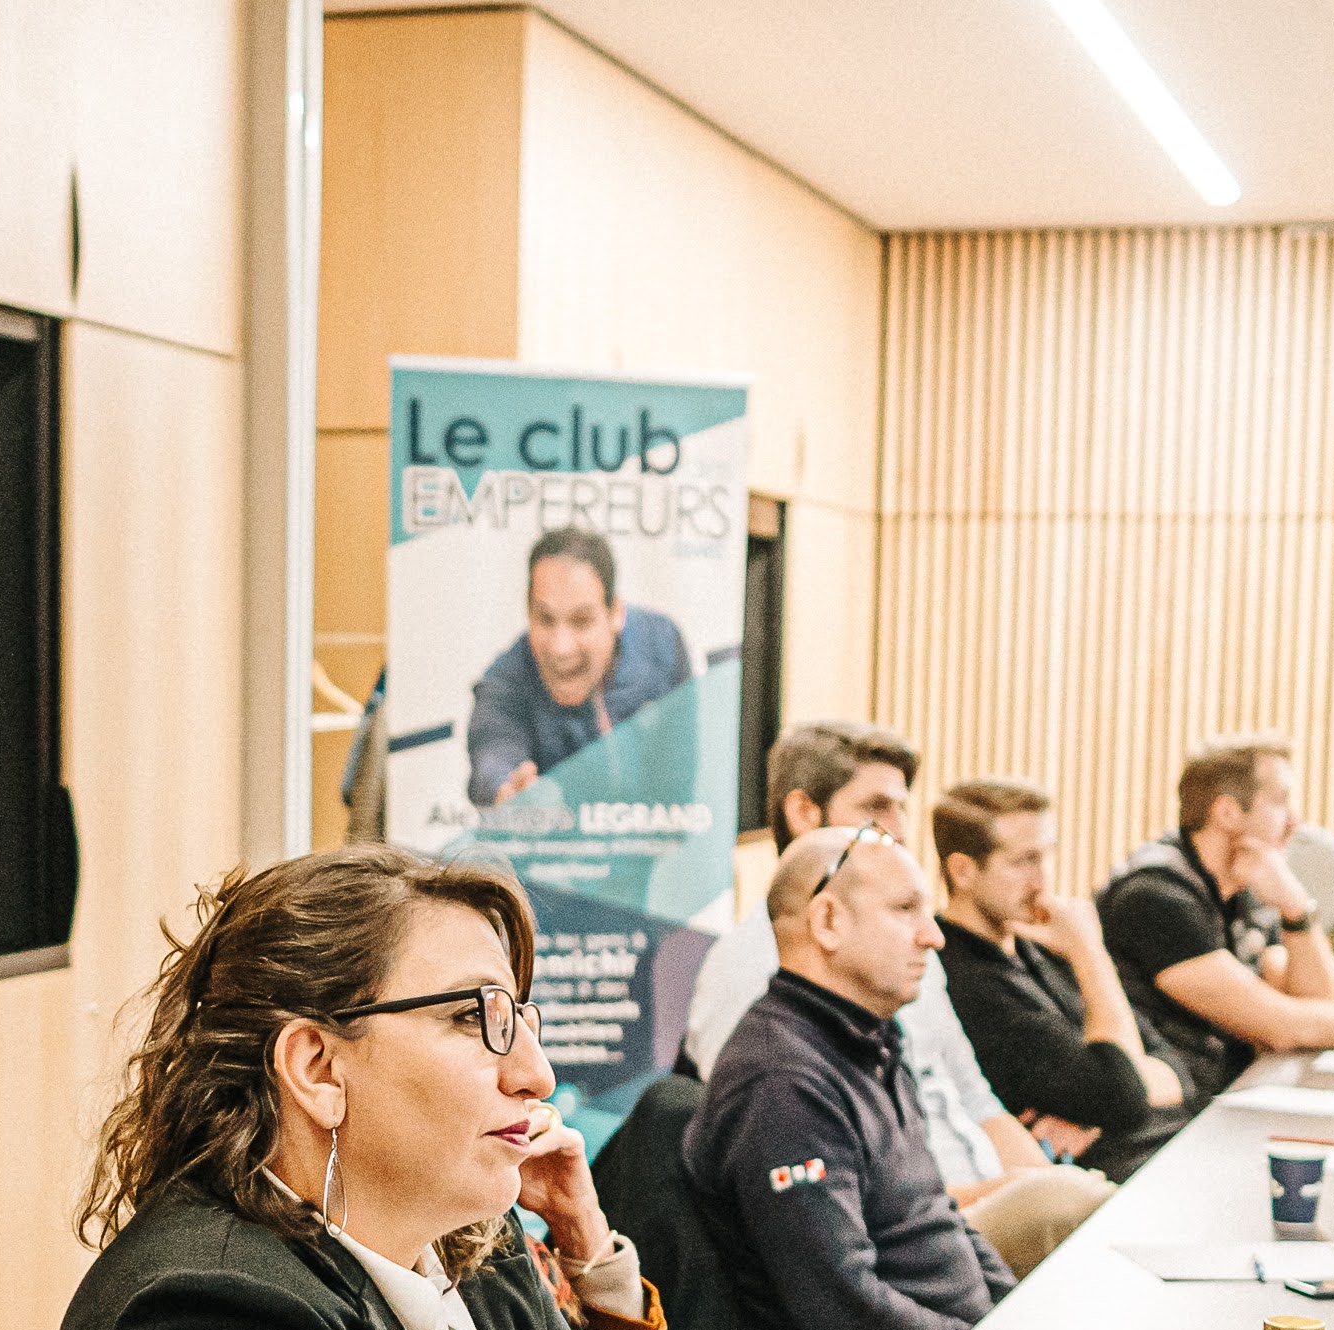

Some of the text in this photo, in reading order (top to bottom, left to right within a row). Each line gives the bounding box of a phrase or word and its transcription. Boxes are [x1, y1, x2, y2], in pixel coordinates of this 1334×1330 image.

[407, 397, 682, 475] Le club
[407, 467, 733, 540] EMPEREURS
[578, 801, 713, 835] LEGRAND
